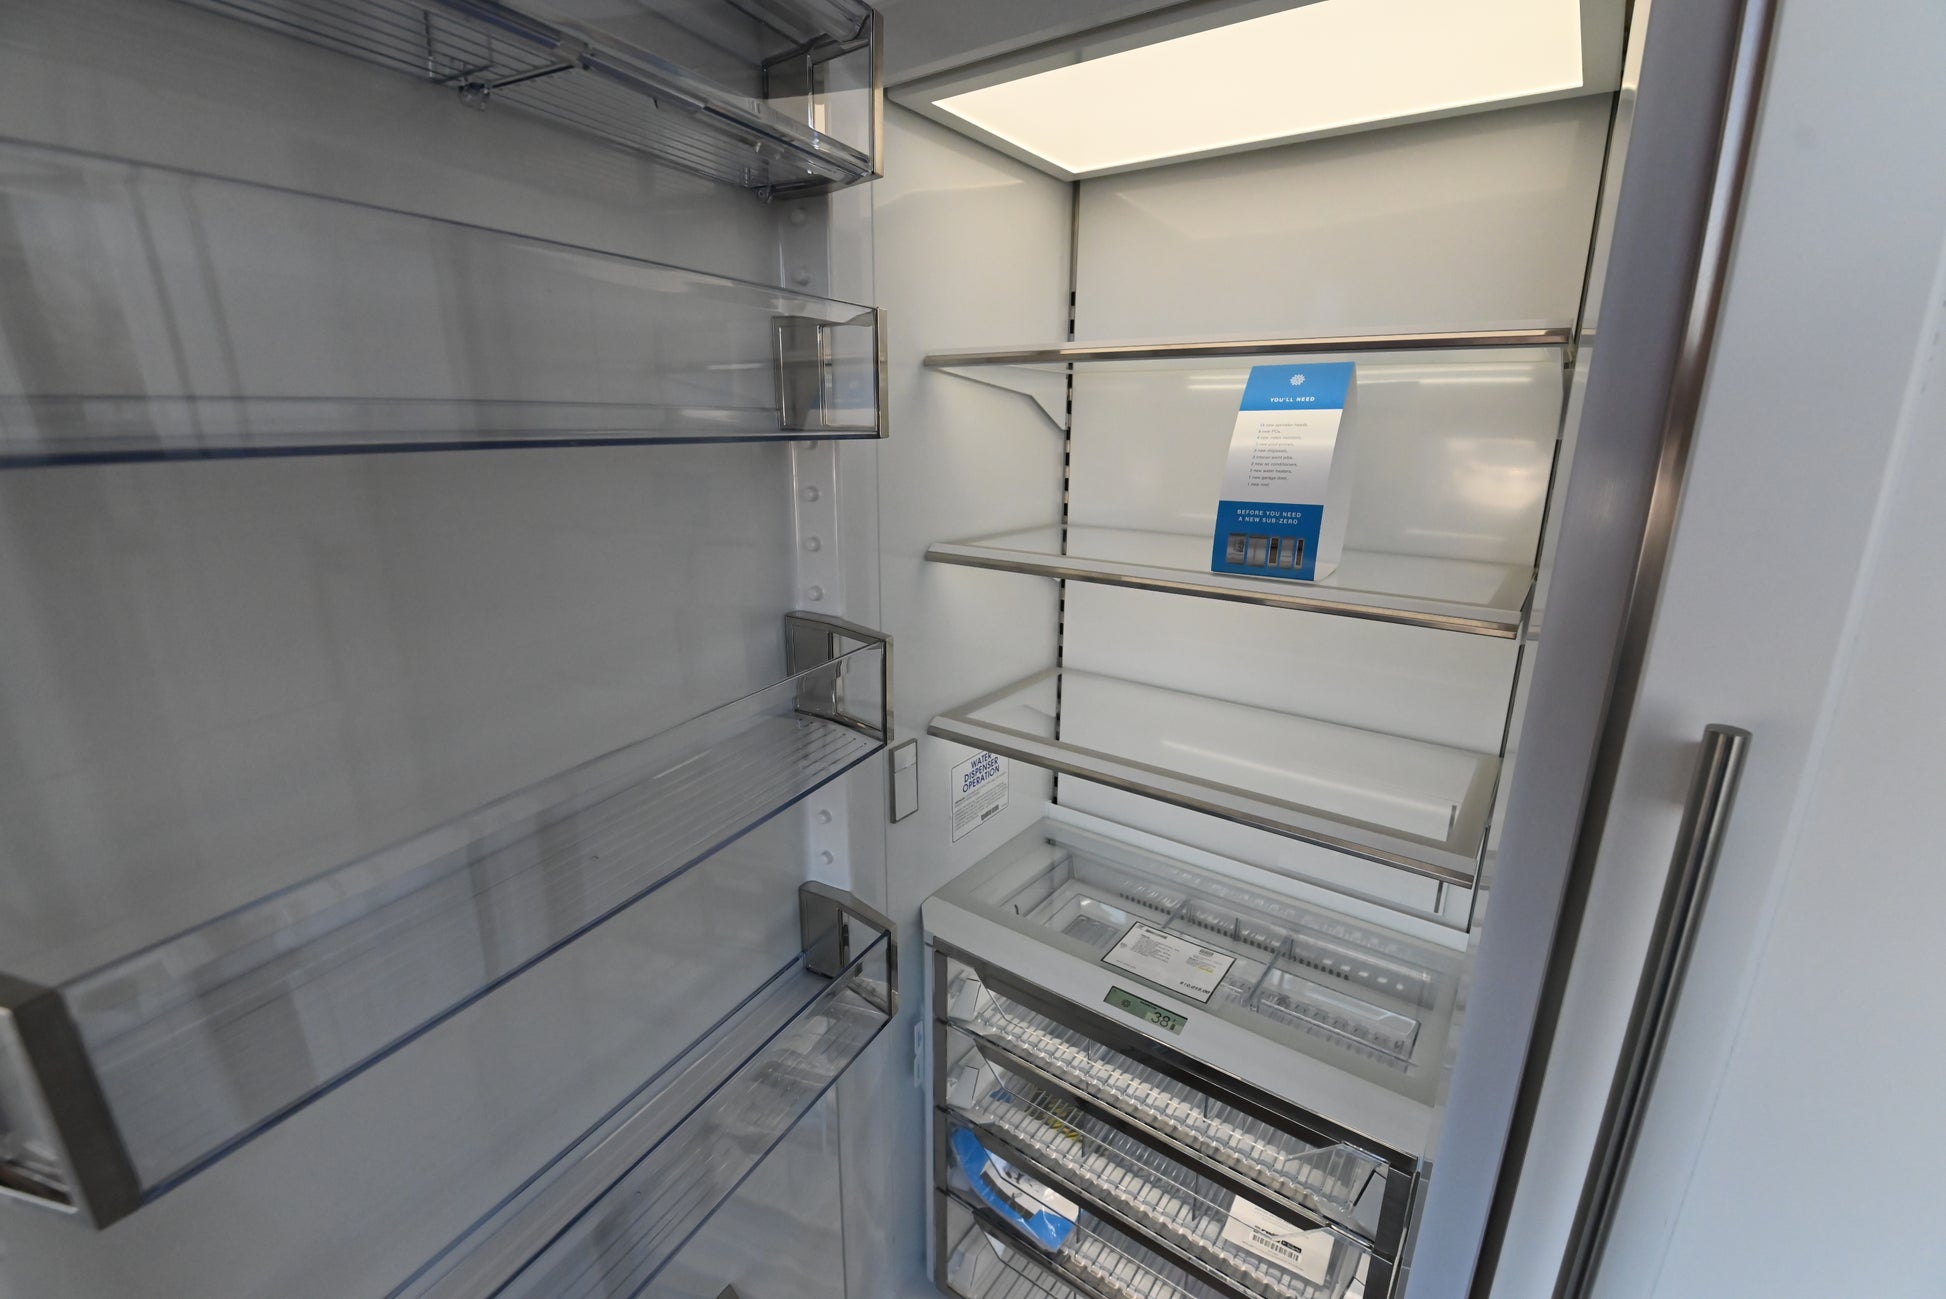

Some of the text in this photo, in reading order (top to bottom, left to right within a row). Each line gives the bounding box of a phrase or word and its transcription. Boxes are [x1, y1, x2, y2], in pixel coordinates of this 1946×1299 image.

[1261, 517, 1298, 525] SUB-ZERO
[964, 756, 999, 783] DISPENSER
[970, 752, 992, 769] WATER
[962, 764, 1000, 793] OPERATION
